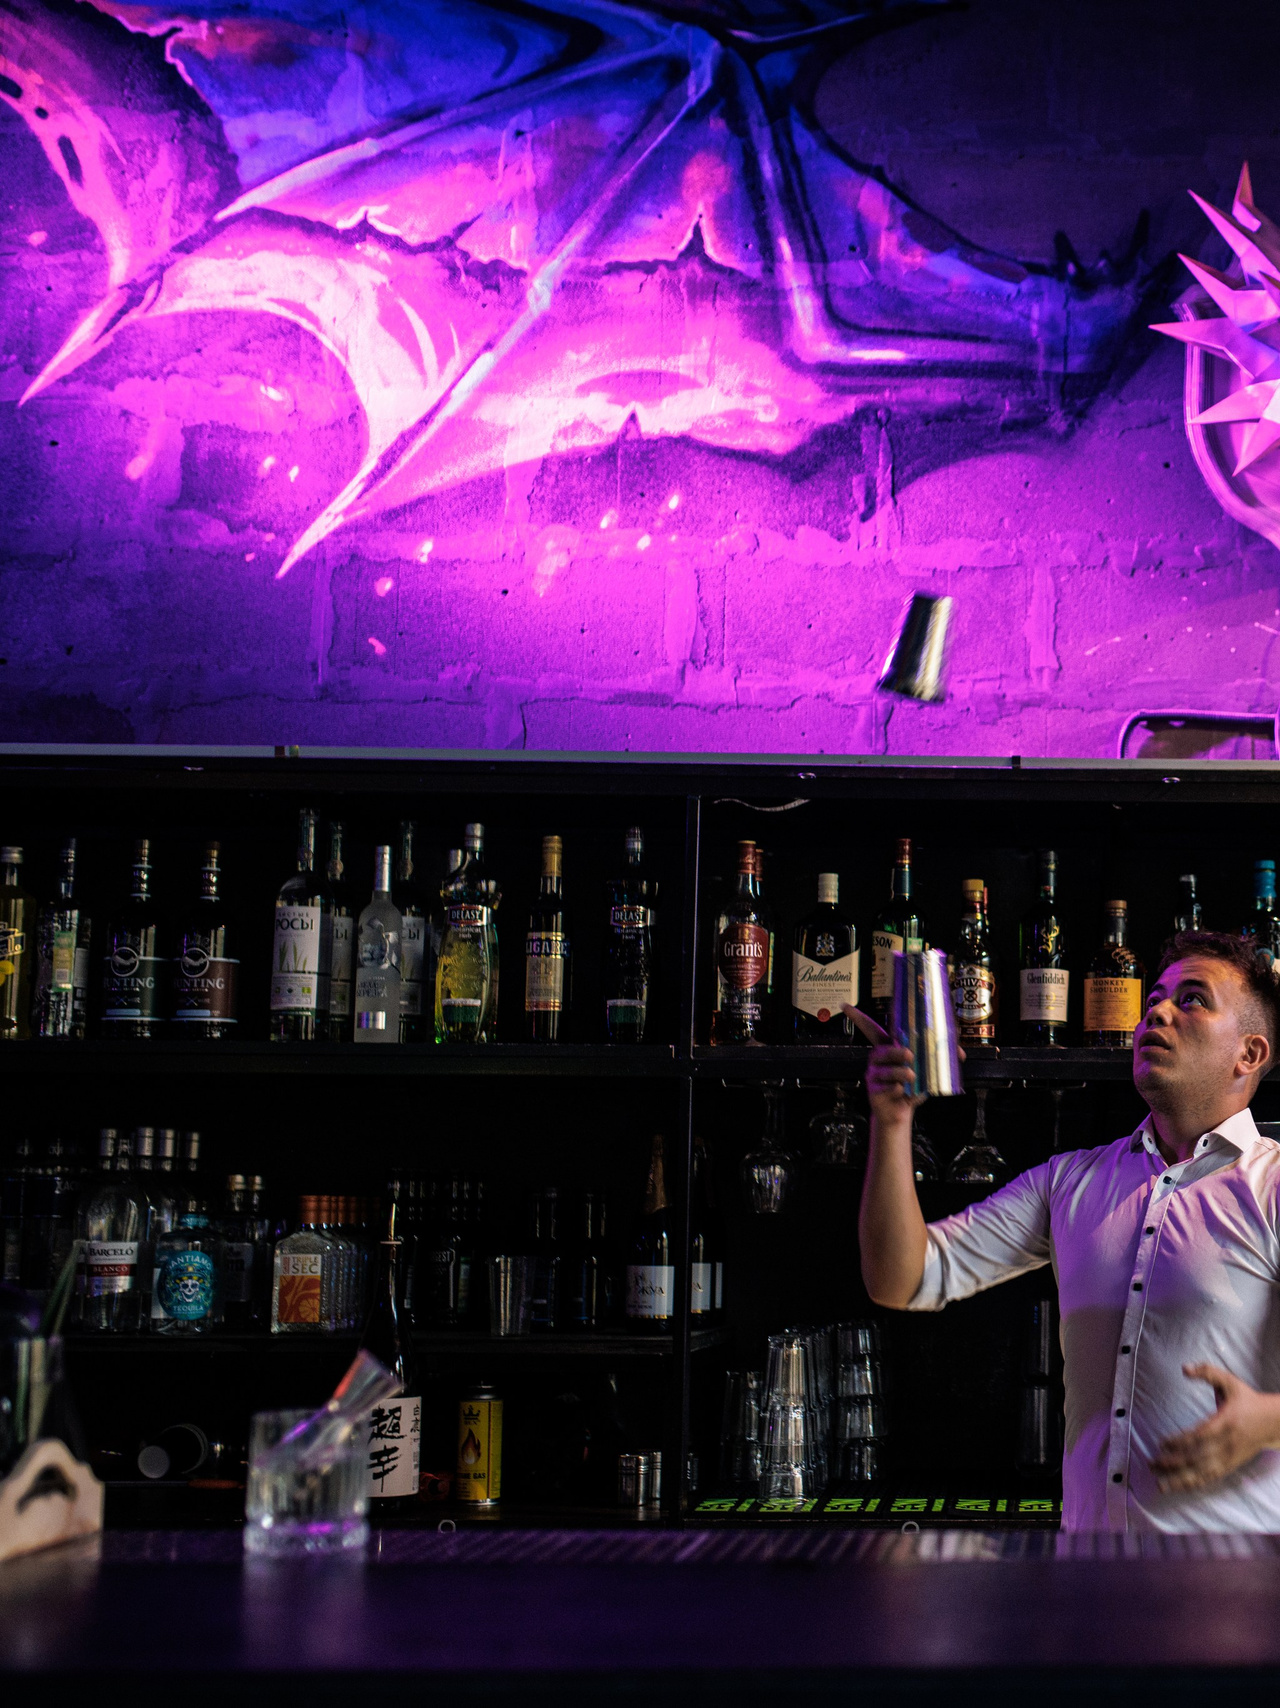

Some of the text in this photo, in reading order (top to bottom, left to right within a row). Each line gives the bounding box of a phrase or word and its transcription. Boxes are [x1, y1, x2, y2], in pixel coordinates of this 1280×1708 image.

[451, 910, 481, 920] DELASY
[614, 911, 644, 921] DELASY
[723, 941, 763, 957] Grant's
[796, 965, 852, 983] Ballantine's
[1026, 972, 1066, 985] Glenfiddich
[954, 977, 989, 988] CHIVAS
[1092, 979, 1125, 987] MONKEY
[89, 1247, 134, 1257] BARCELÓ
[92, 1265, 128, 1273] BLANCO
[291, 1263, 319, 1274] SEC
[472, 1472, 486, 1480] GAS
